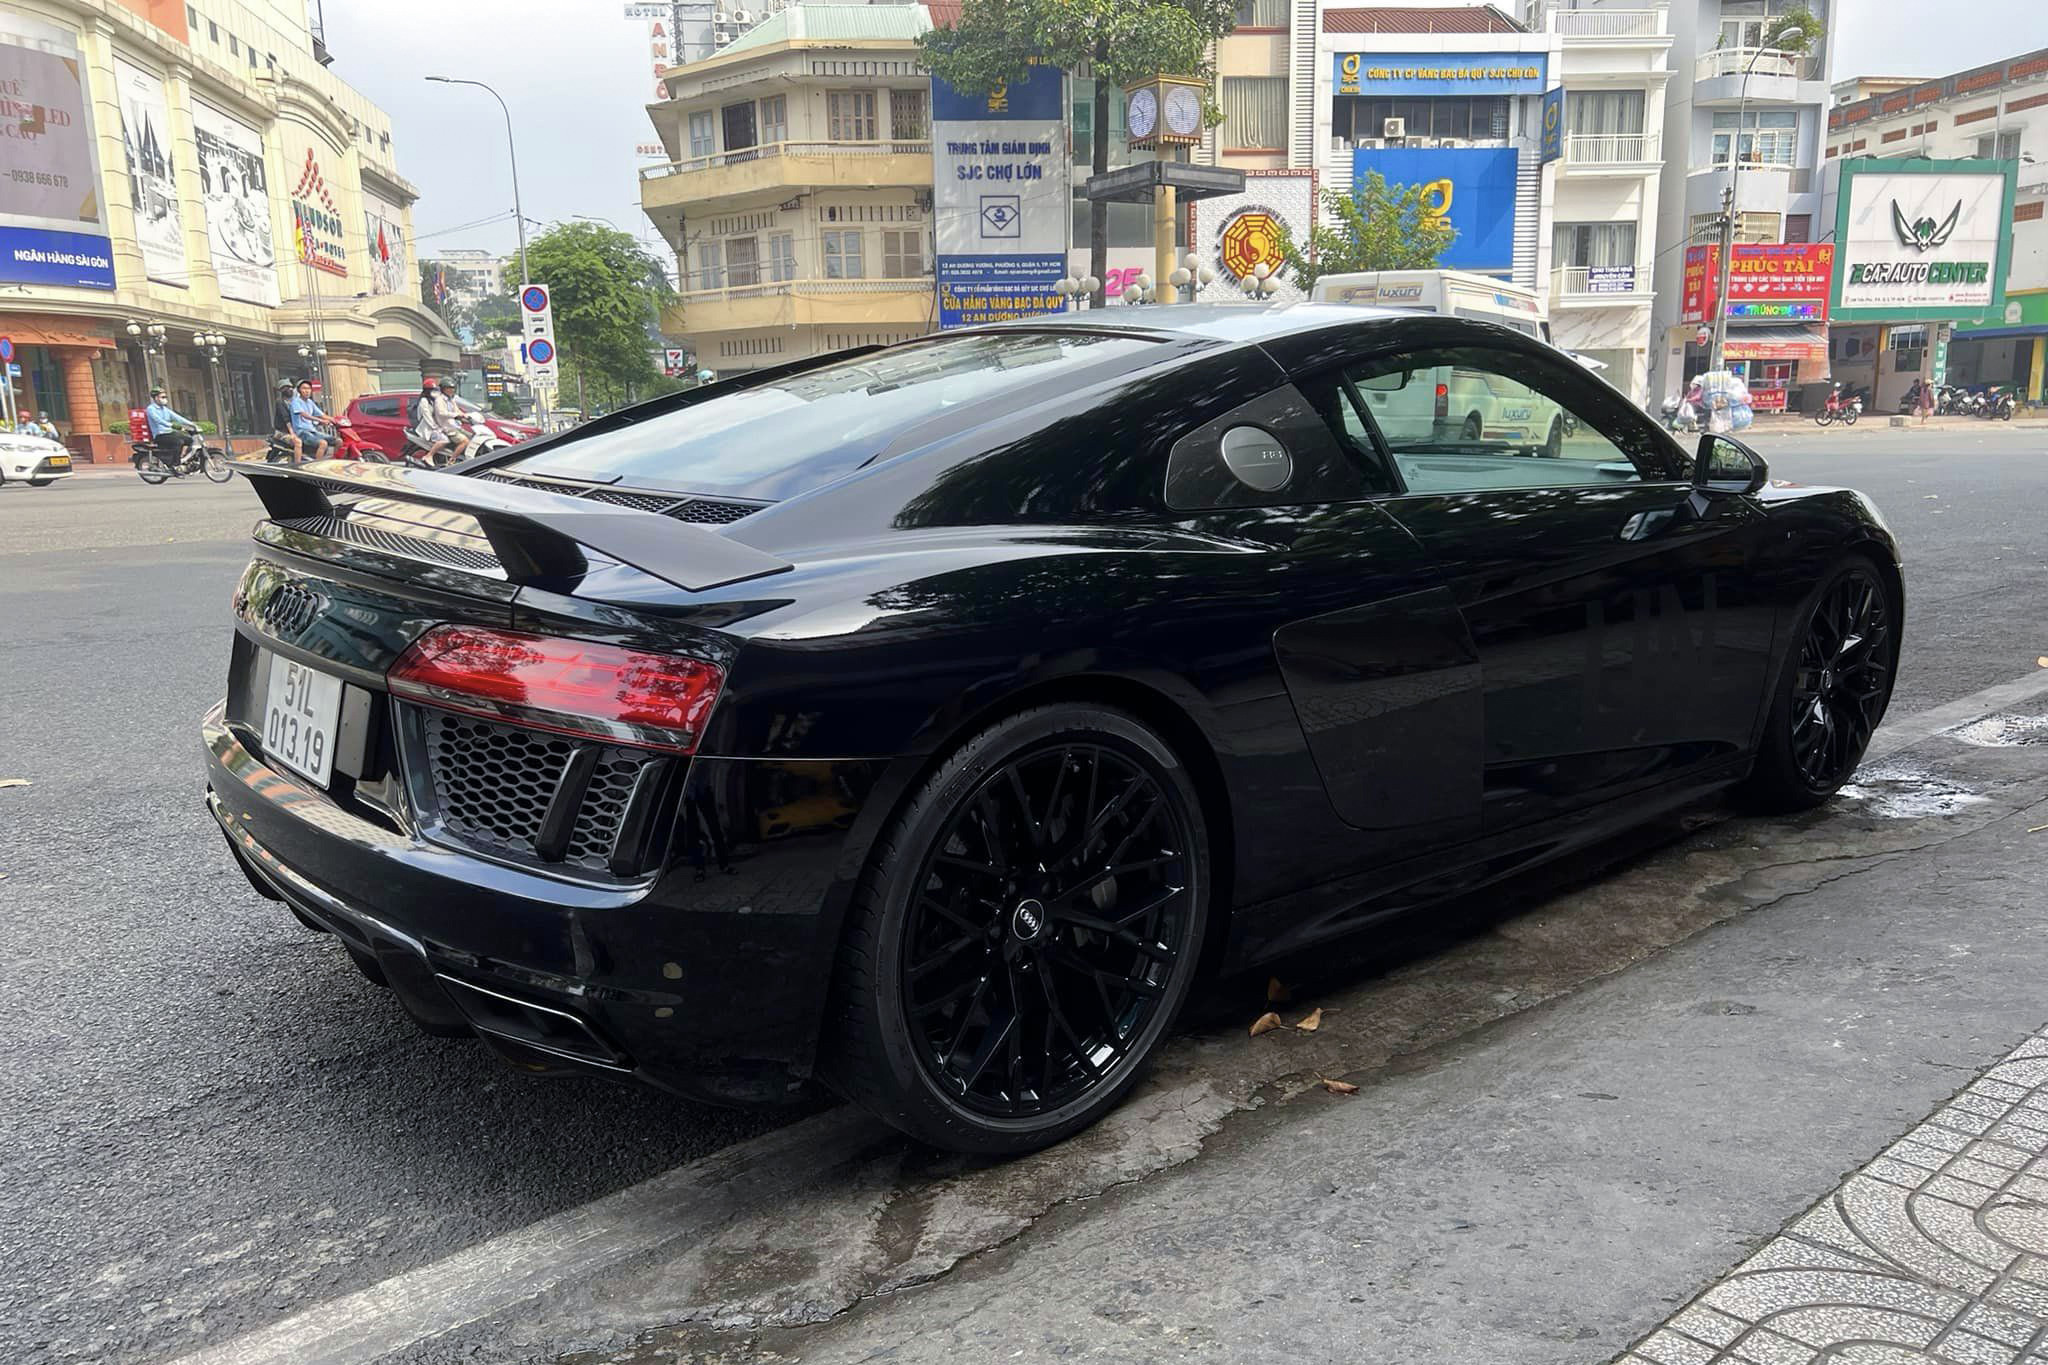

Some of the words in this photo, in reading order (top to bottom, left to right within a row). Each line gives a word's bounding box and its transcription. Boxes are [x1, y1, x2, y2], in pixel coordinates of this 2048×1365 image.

[1488, 68, 1505, 79] SJC
[946, 142, 977, 155] TRUNG
[981, 140, 1000, 155] TÂM
[1002, 140, 1026, 155] GIÁM
[957, 165, 983, 180] SJC
[987, 163, 1013, 182] CHỢ
[1016, 162, 1042, 180] LỚN
[14, 248, 46, 263] NGÂN
[46, 250, 75, 265] HÀNG
[75, 254, 90, 267] SÀI
[90, 256, 109, 269] GÒN
[1730, 256, 1778, 273] PHÚC
[1784, 255, 1814, 273] TÀI
[943, 293, 961, 310] CỬA
[963, 294, 987, 310] HÀNG
[989, 294, 1012, 310] VÀNG
[1014, 297, 1032, 311] BẠC
[1032, 293, 1045, 309] ĐÁ
[1379, 287, 1423, 299] luxury
[961, 314, 972, 322] 12
[974, 314, 986, 322] AN
[1501, 407, 1533, 422] luxury
[284, 662, 315, 719] 51L
[268, 706, 325, 776] 013.19
